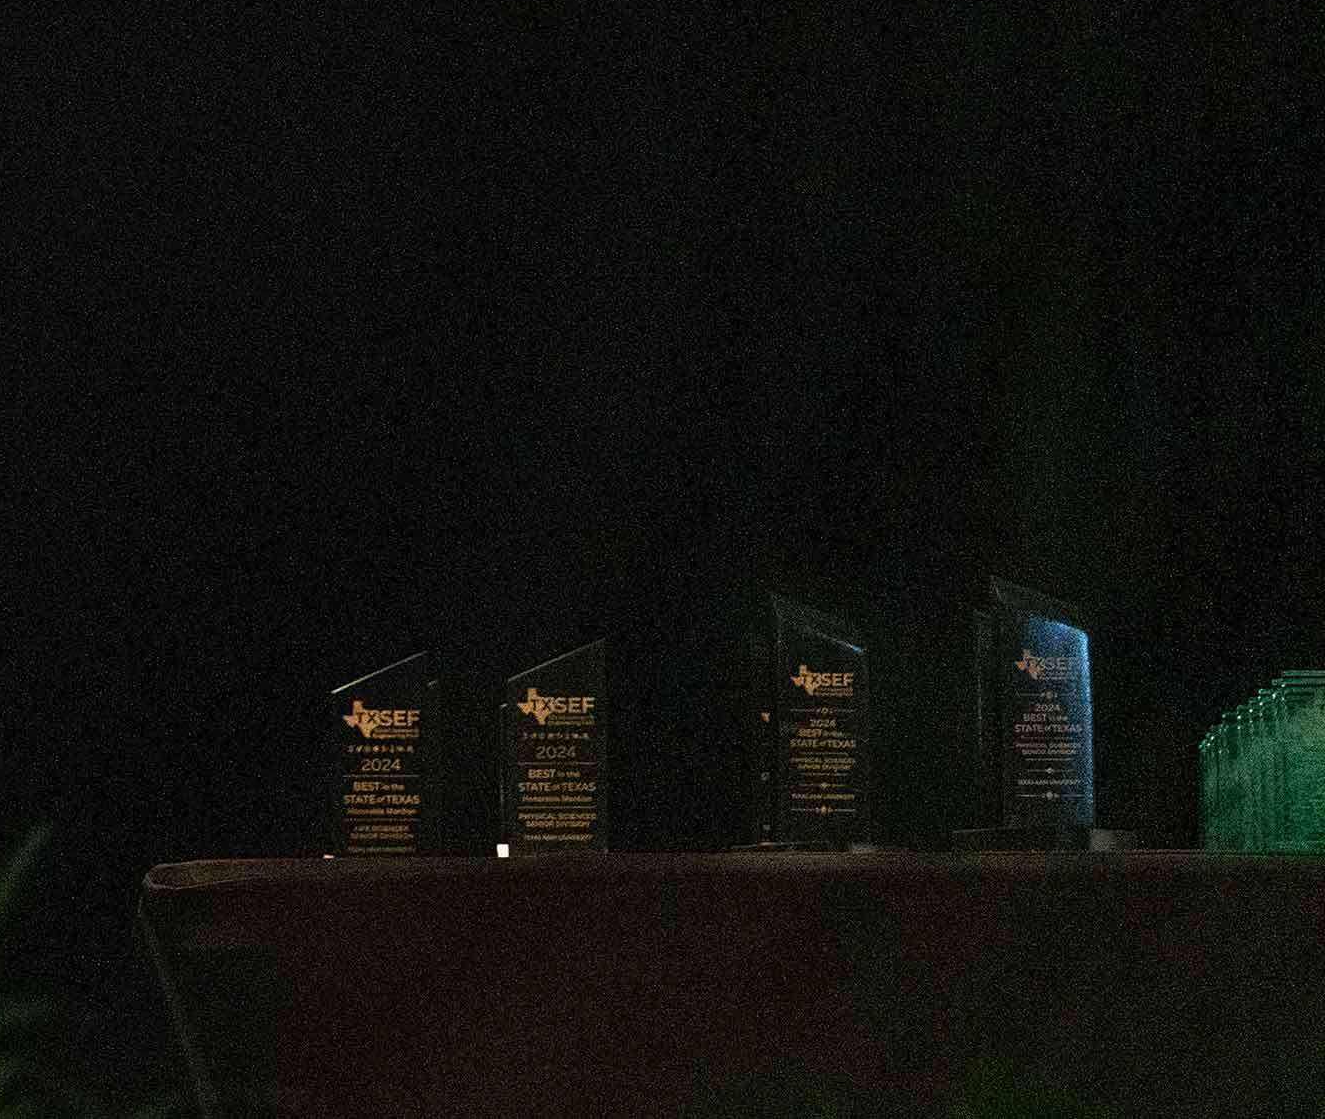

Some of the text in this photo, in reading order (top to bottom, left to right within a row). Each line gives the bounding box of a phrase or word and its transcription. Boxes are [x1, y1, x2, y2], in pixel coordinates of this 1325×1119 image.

[533, 697, 596, 713] TXSEF
[1035, 703, 1061, 712] 2024
[1014, 724, 1044, 733] STATE
[790, 738, 819, 748] STATE
[536, 745, 576, 759] 2024
[361, 758, 401, 772] 2024
[528, 768, 555, 778] BEST
[353, 781, 380, 791] BEST
[518, 782, 550, 792] STATE
[561, 782, 597, 792] TEXAS
[344, 794, 376, 804] STATE
[386, 794, 421, 804] TEXAS
